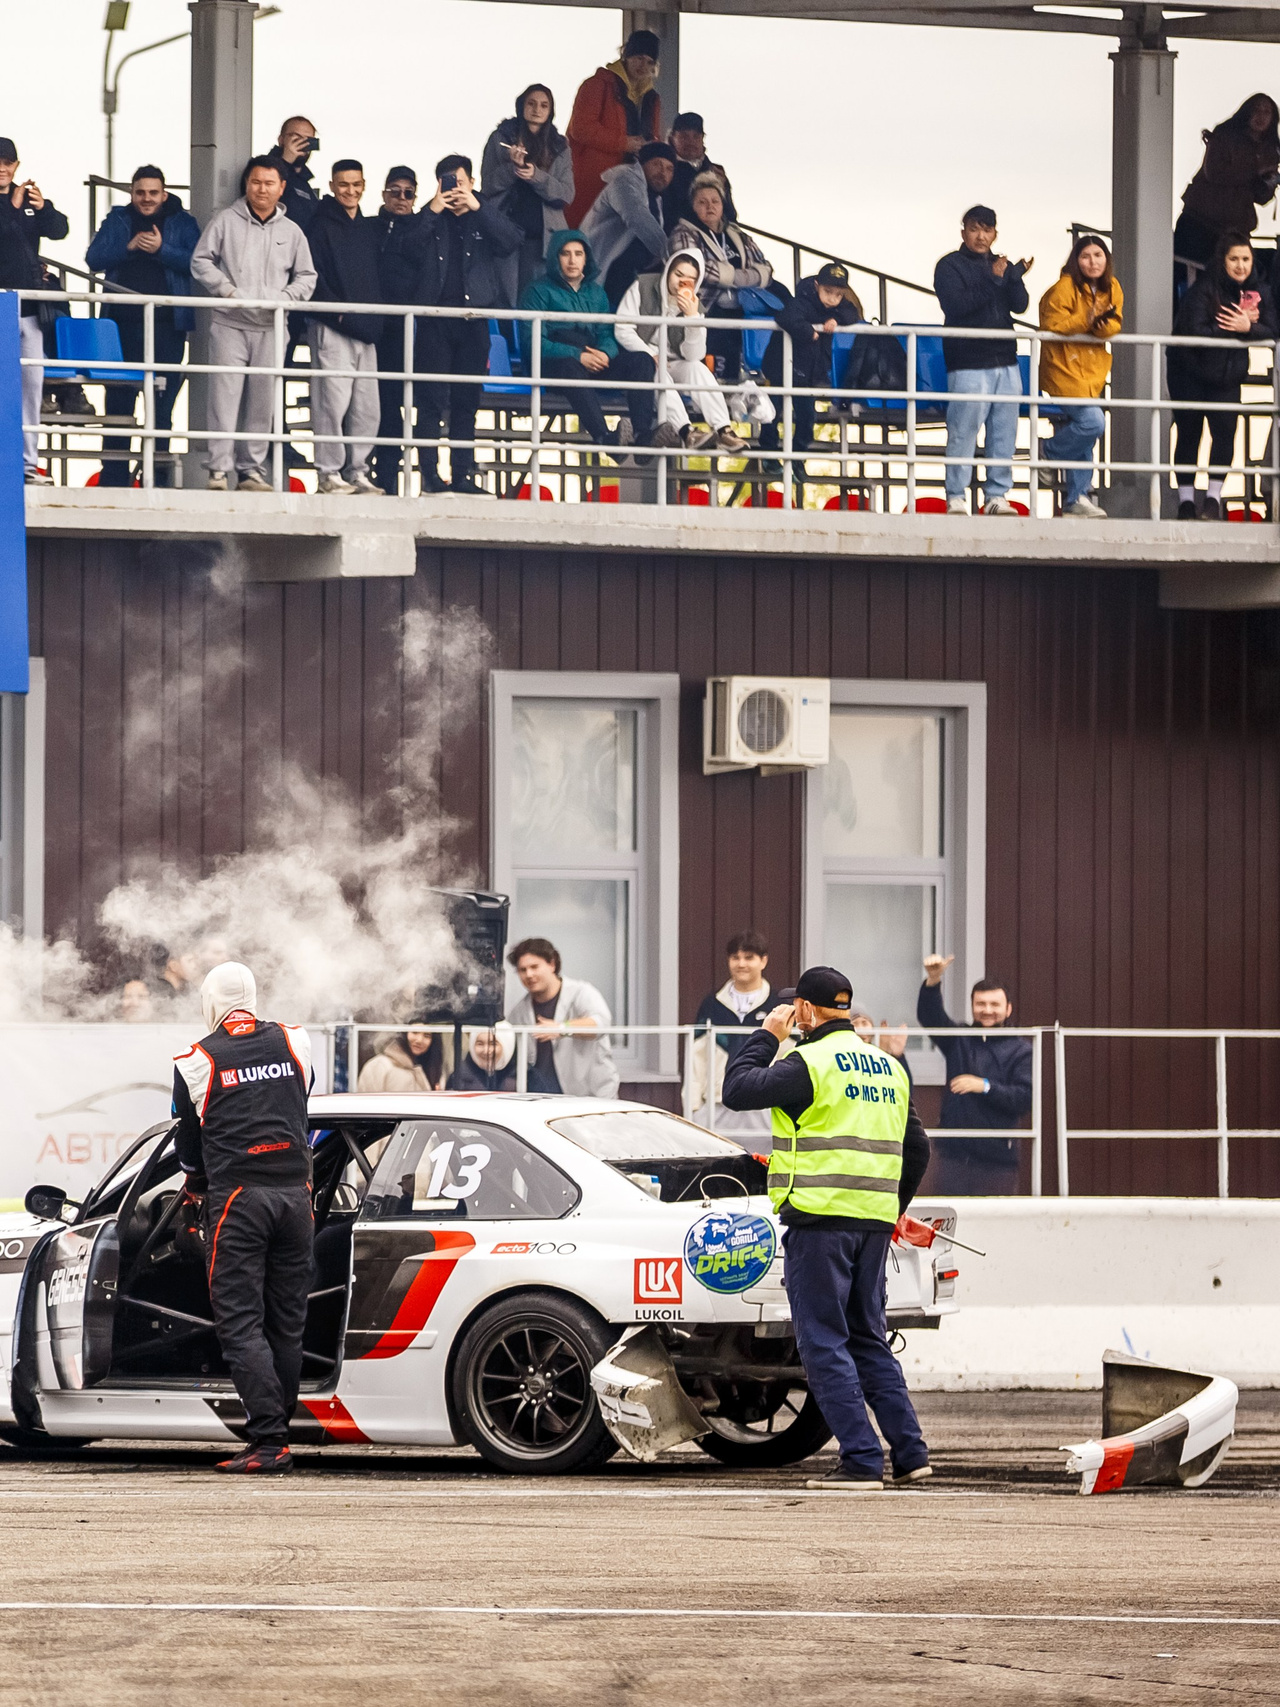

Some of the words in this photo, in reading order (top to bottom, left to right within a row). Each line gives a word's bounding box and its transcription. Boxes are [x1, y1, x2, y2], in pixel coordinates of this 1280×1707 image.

[237, 1062, 295, 1083] LUKOIL
[834, 1051, 893, 1078] СУДЬЯ
[845, 1083, 879, 1103] ФМС
[882, 1086, 896, 1105] РК
[426, 1140, 492, 1200] 13
[497, 1244, 527, 1253] ecto
[527, 1242, 577, 1255] 100
[731, 1232, 759, 1246] GORILLA
[696, 1243, 769, 1275] DRIFT
[635, 1310, 685, 1321] LUKOIL
